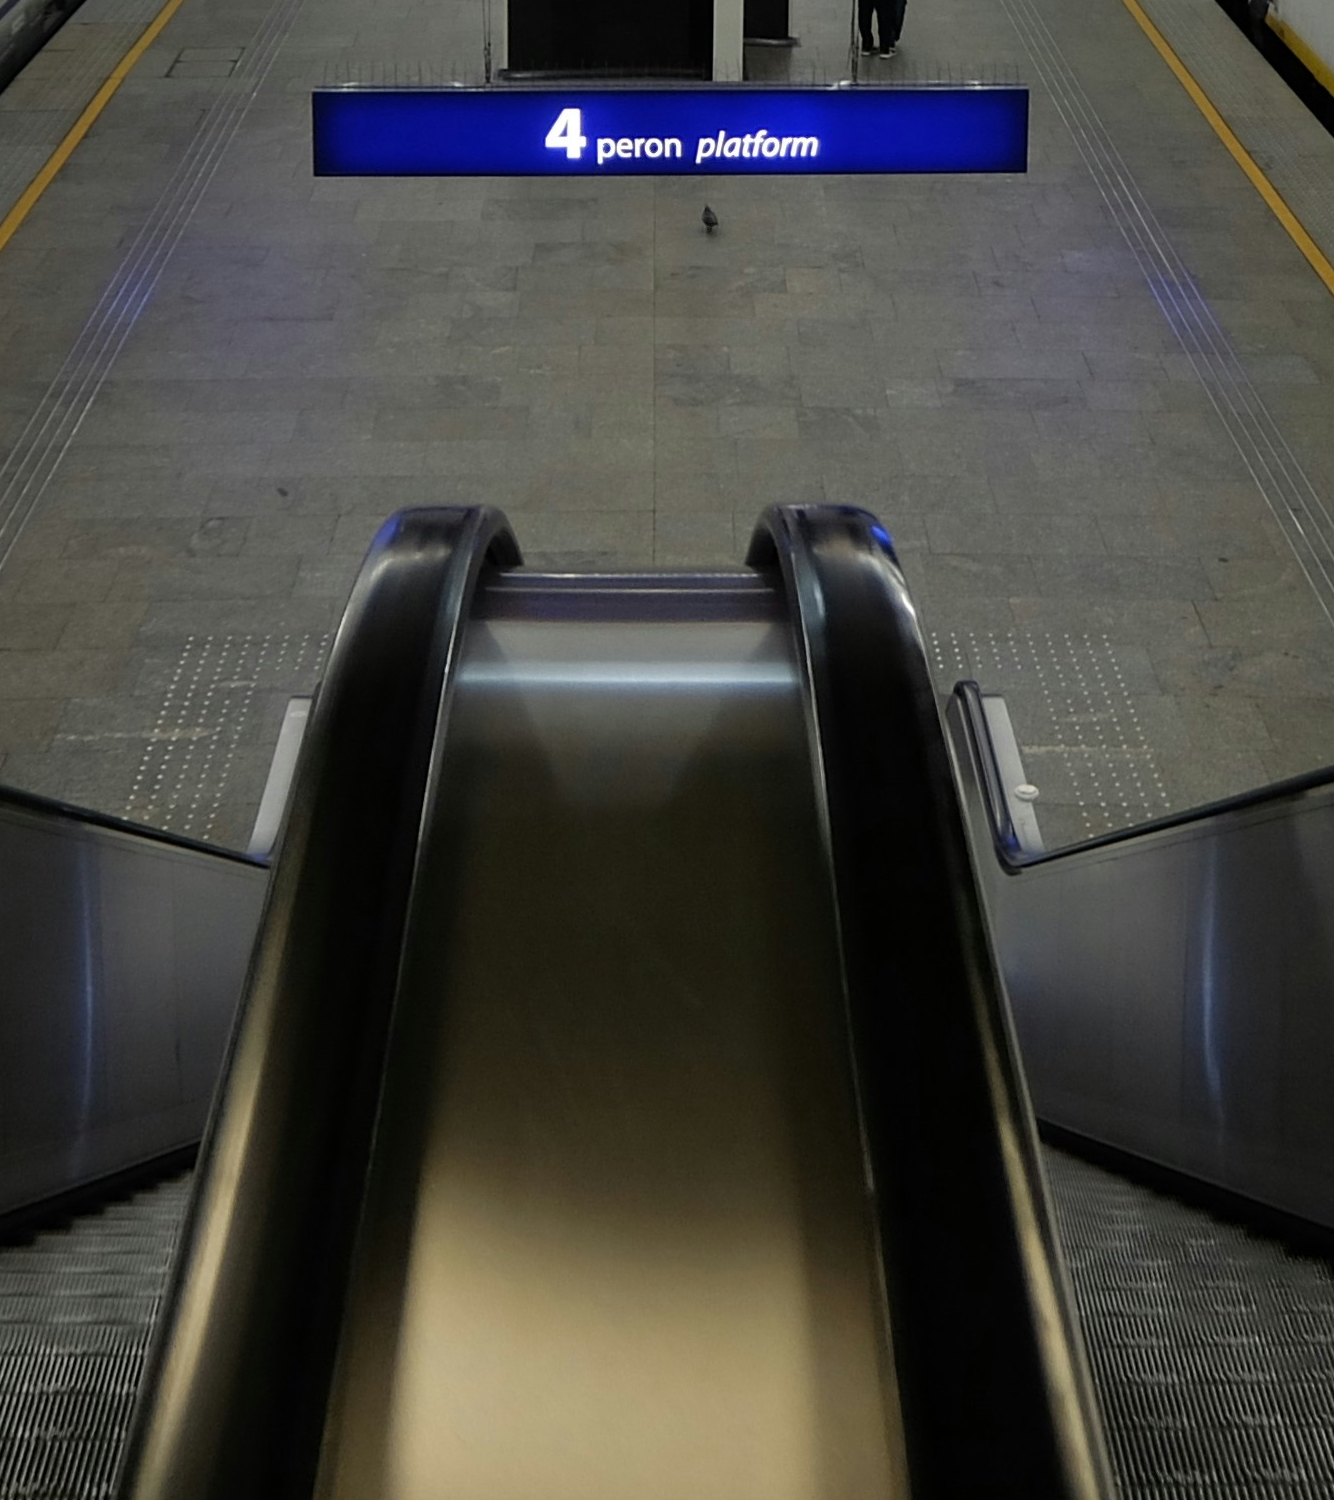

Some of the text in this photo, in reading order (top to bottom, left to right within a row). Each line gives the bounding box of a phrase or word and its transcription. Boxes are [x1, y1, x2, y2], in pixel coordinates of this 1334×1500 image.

[544, 107, 820, 165] 4 peron platform
